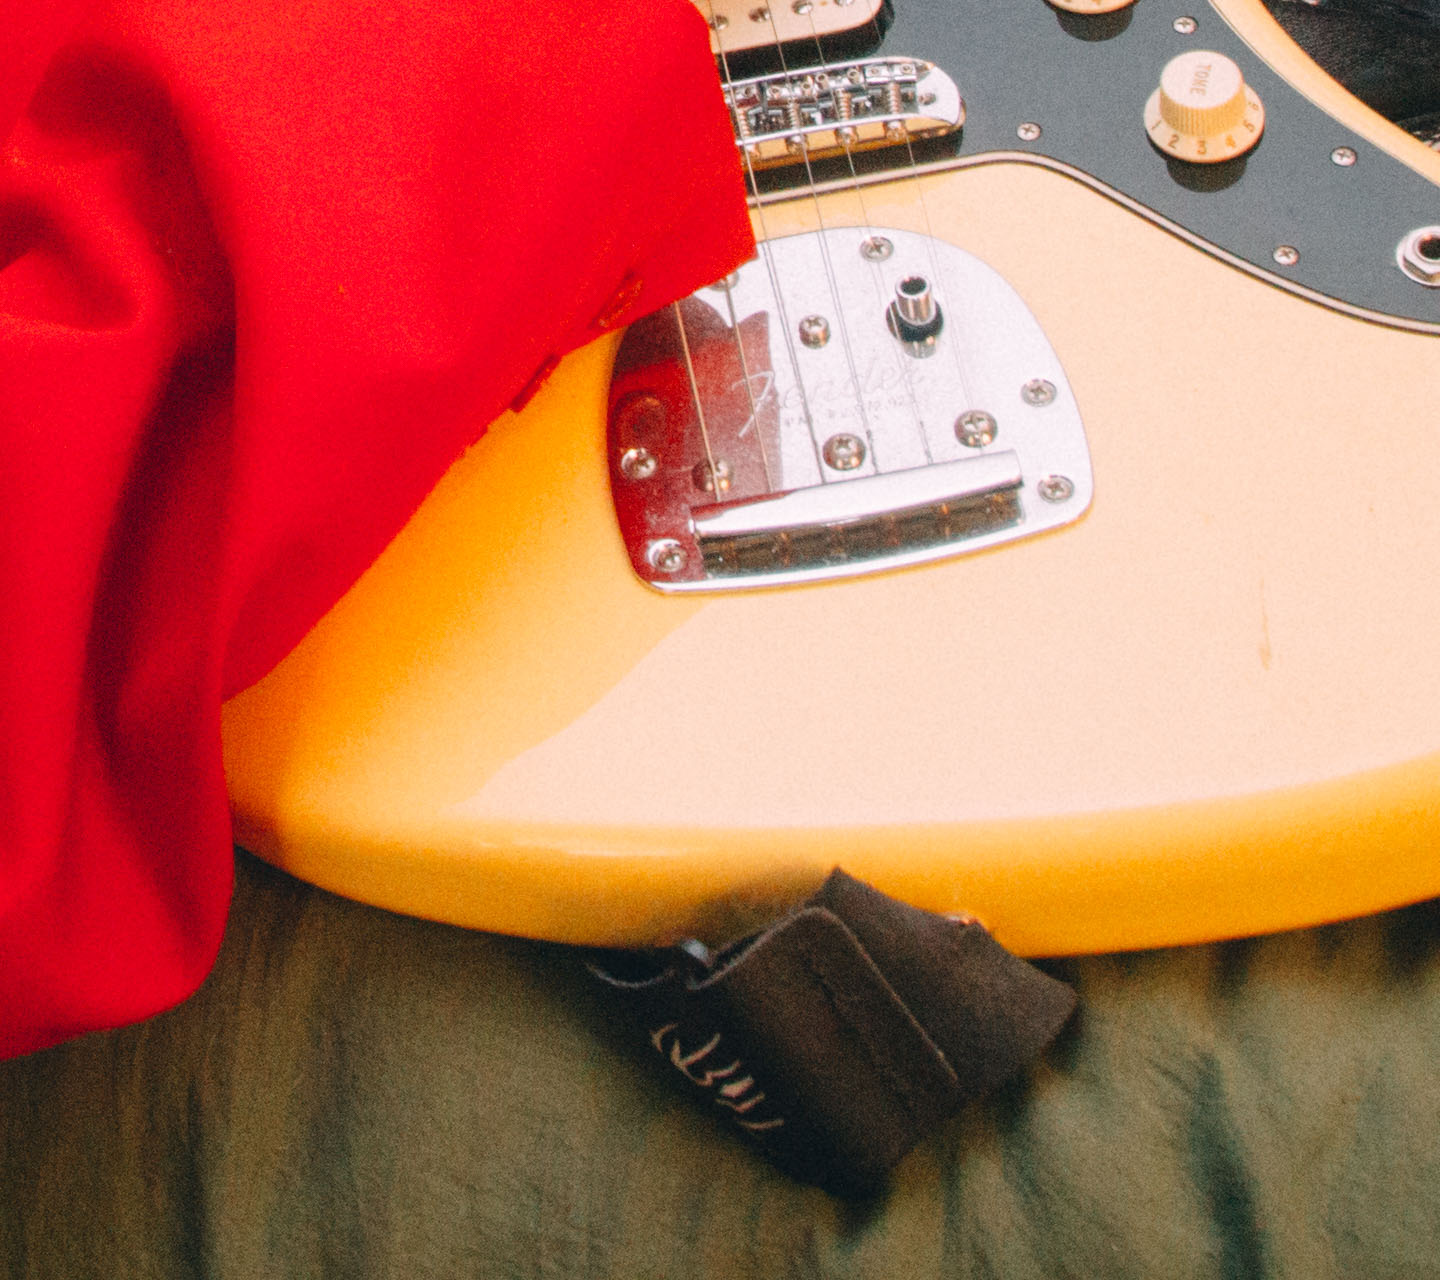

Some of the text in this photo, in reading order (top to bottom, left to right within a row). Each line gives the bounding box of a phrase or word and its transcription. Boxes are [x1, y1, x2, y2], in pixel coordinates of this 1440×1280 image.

[1188, 62, 1212, 96] TONE
[1167, 132, 1180, 150] 2
[1195, 137, 1208, 156] 3
[1224, 133, 1237, 149] 4
